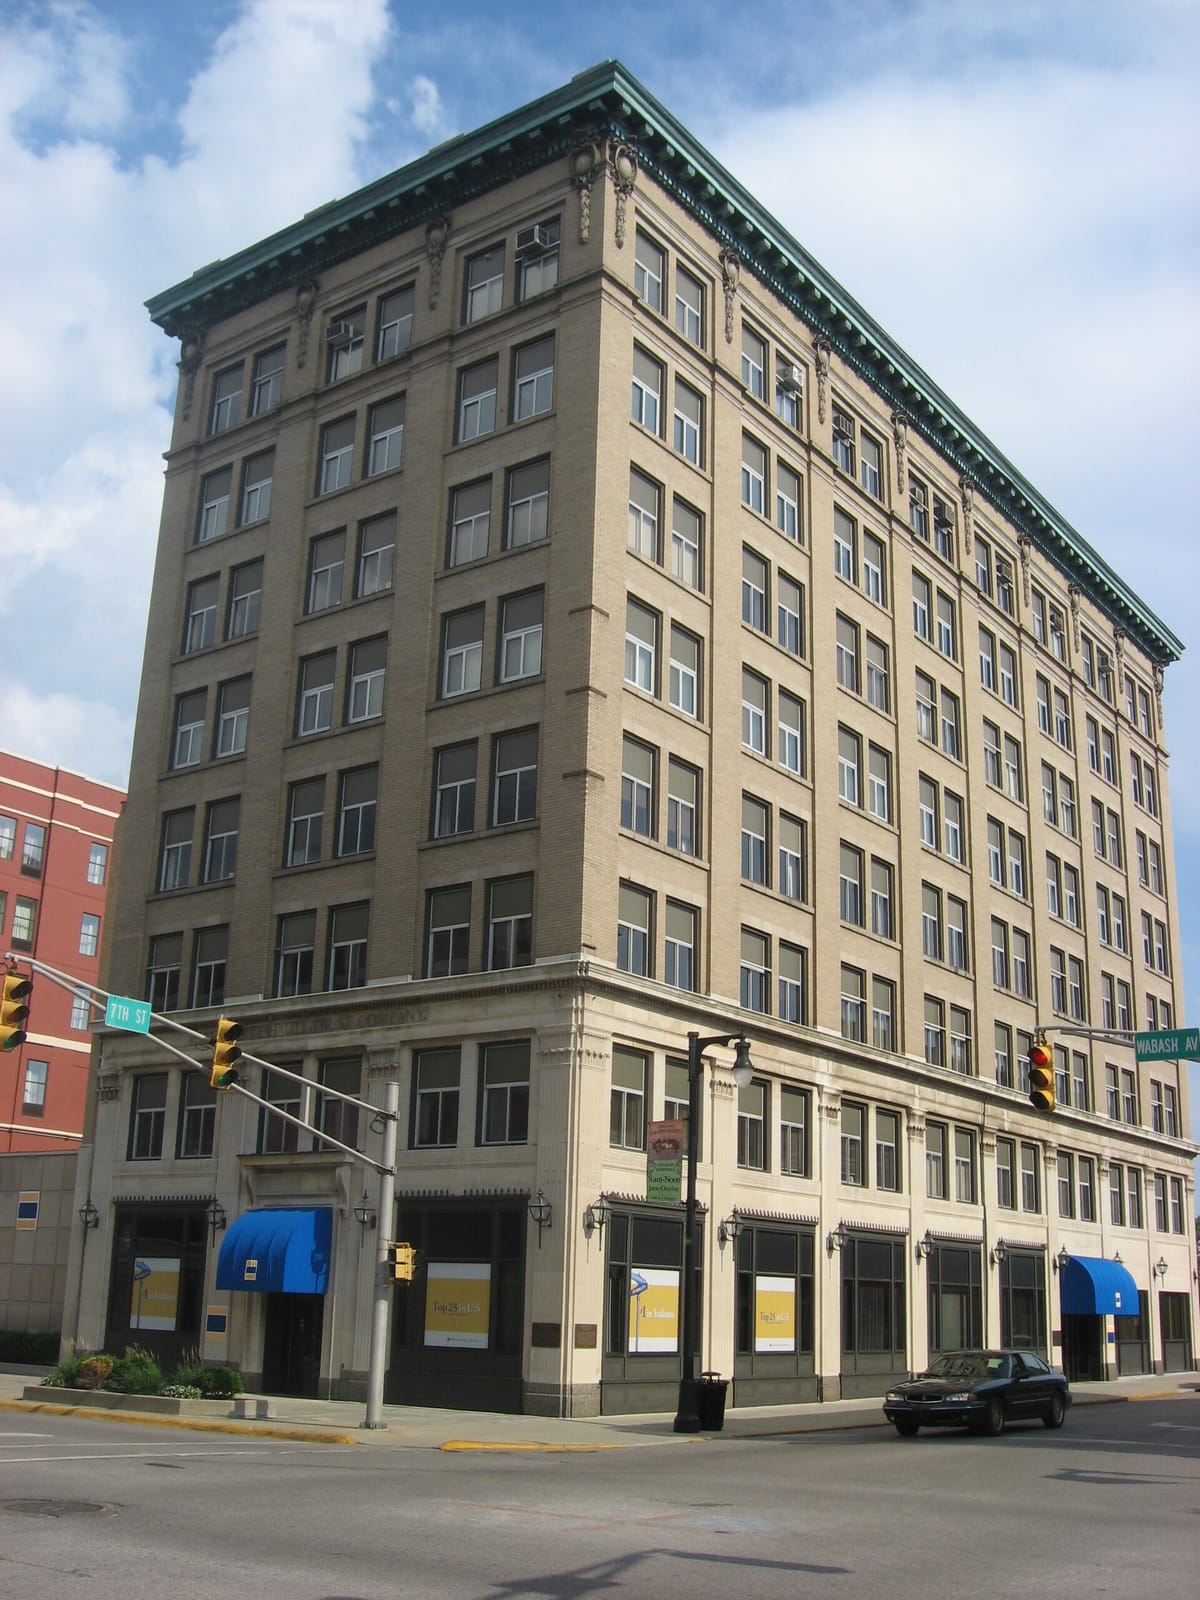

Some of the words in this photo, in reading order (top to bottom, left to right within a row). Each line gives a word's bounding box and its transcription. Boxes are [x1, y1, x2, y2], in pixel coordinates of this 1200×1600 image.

[110, 1003, 129, 1022] 7TH
[135, 1008, 148, 1025] ST
[1136, 1036, 1179, 1055] WABASH
[432, 1302, 448, 1315] Top
[448, 1301, 458, 1313] 25
[760, 1311, 770, 1324] Top
